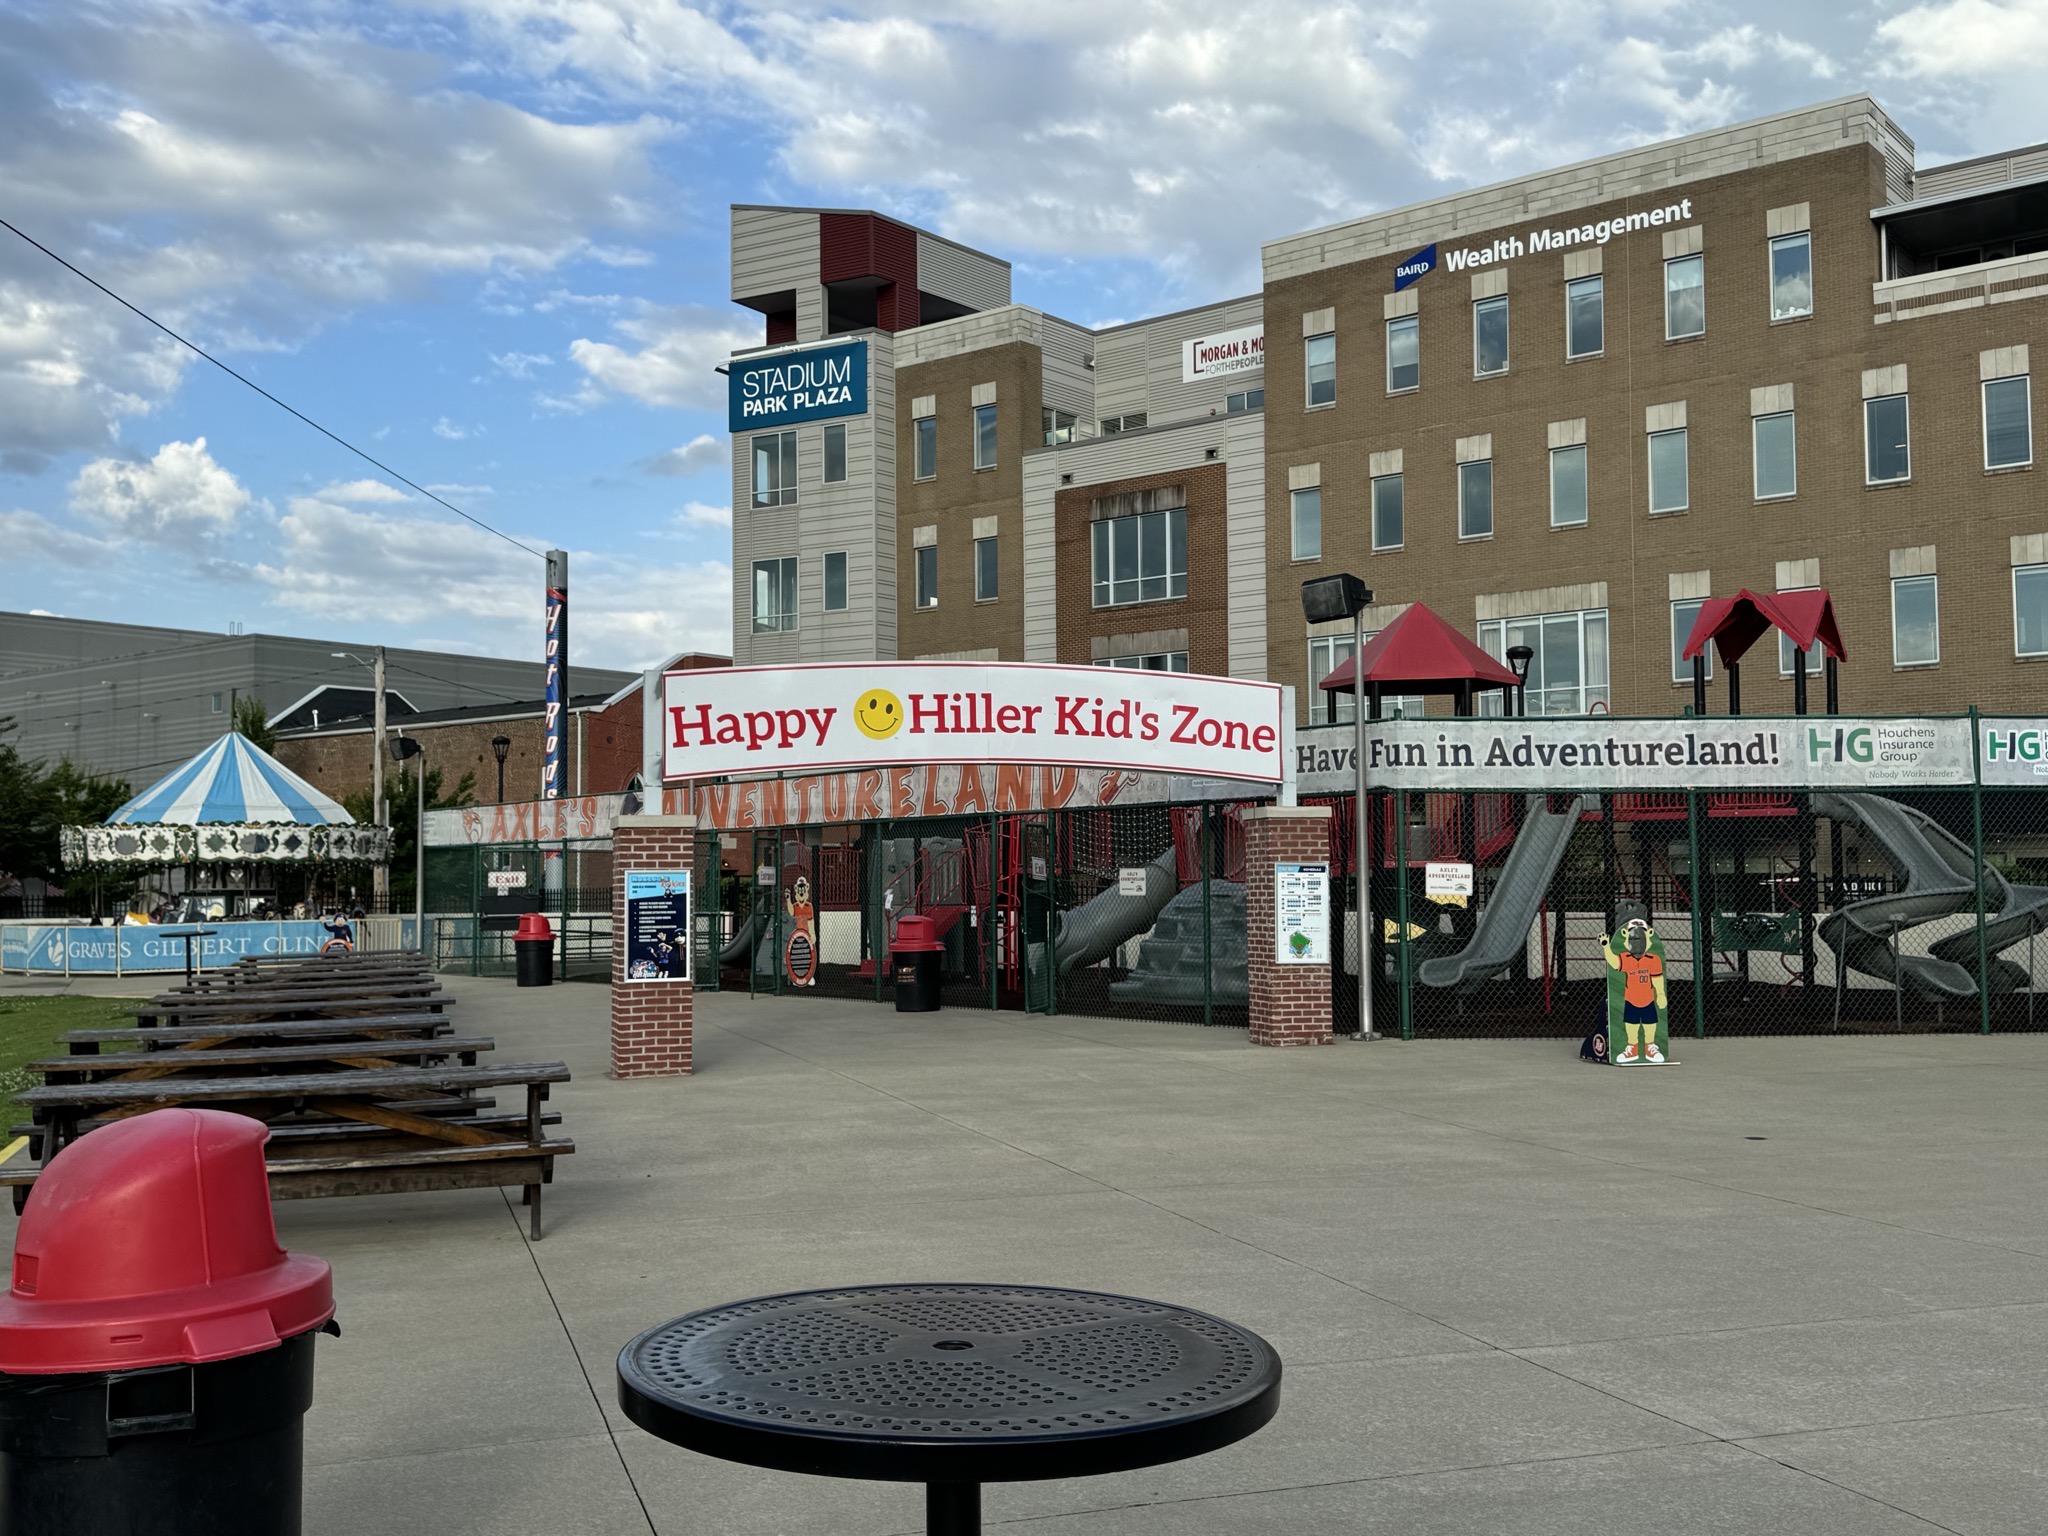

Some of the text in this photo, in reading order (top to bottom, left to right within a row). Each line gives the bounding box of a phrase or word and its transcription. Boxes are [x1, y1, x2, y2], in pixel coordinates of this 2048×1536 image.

[1445, 198, 1692, 273] Wealth Management
[1396, 261, 1429, 278] BAIRD
[1200, 342, 1239, 365] MORGAN
[1241, 340, 1248, 356] &
[743, 356, 850, 398] STADIUM
[743, 385, 852, 417] PARK PLAZA
[668, 692, 1276, 753] Happy Hiller Kid's Zone
[1878, 727, 1936, 739] Houchens
[1297, 733, 1779, 774] Have Fun in Adventureland!
[1879, 739, 1935, 750] Insurance
[1880, 751, 1918, 763] Group
[1869, 770, 1899, 780] Nobody
[1901, 769, 1926, 779] Works
[489, 796, 598, 843] AXLE'S
[68, 940, 132, 959] GRAVES
[143, 936, 251, 958] GILBERT
[263, 936, 331, 955] CLIN
